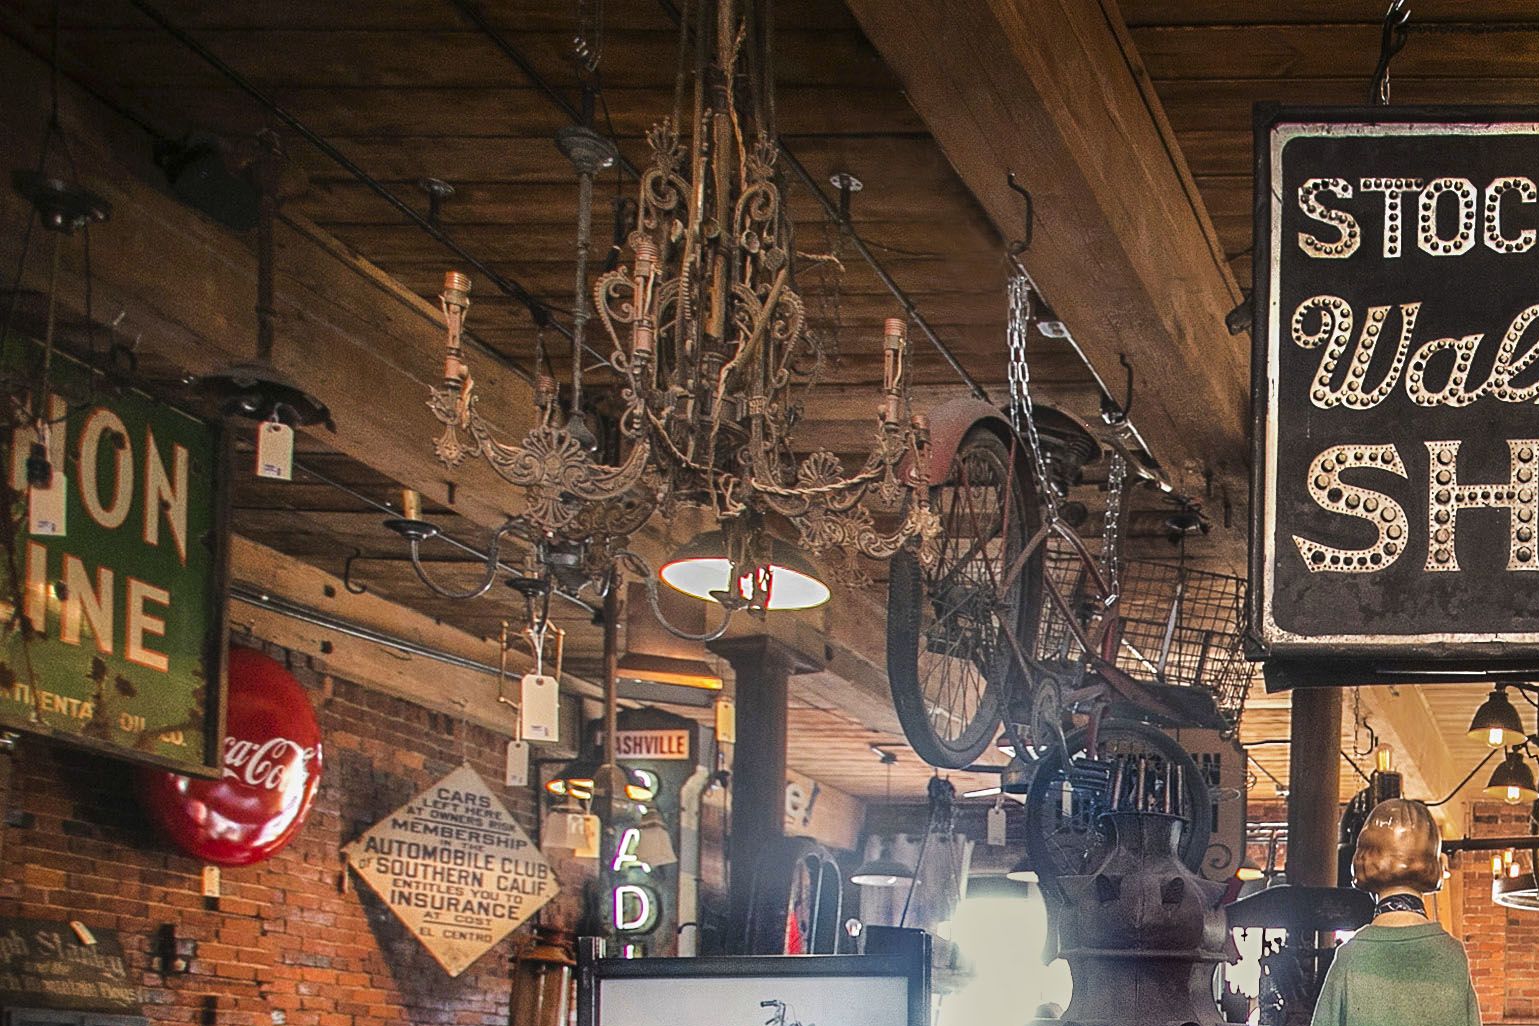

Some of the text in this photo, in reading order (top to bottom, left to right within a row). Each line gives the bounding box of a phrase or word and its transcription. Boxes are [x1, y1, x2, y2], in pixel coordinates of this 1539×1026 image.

[438, 788, 491, 808] CARS
[406, 805, 423, 816] AT
[430, 808, 484, 827] OWNERS
[424, 800, 502, 821] LEFT HERE
[391, 818, 528, 850] MEMBERSHIP
[365, 836, 549, 880] AUTOMOBILE CLUB
[376, 857, 484, 888] SOUTHERN
[392, 878, 523, 905] ENTITLES YOU TO
[390, 889, 520, 921] INSURANCE
[423, 910, 493, 926] AT COST
[419, 926, 493, 943] EL CENTRO
